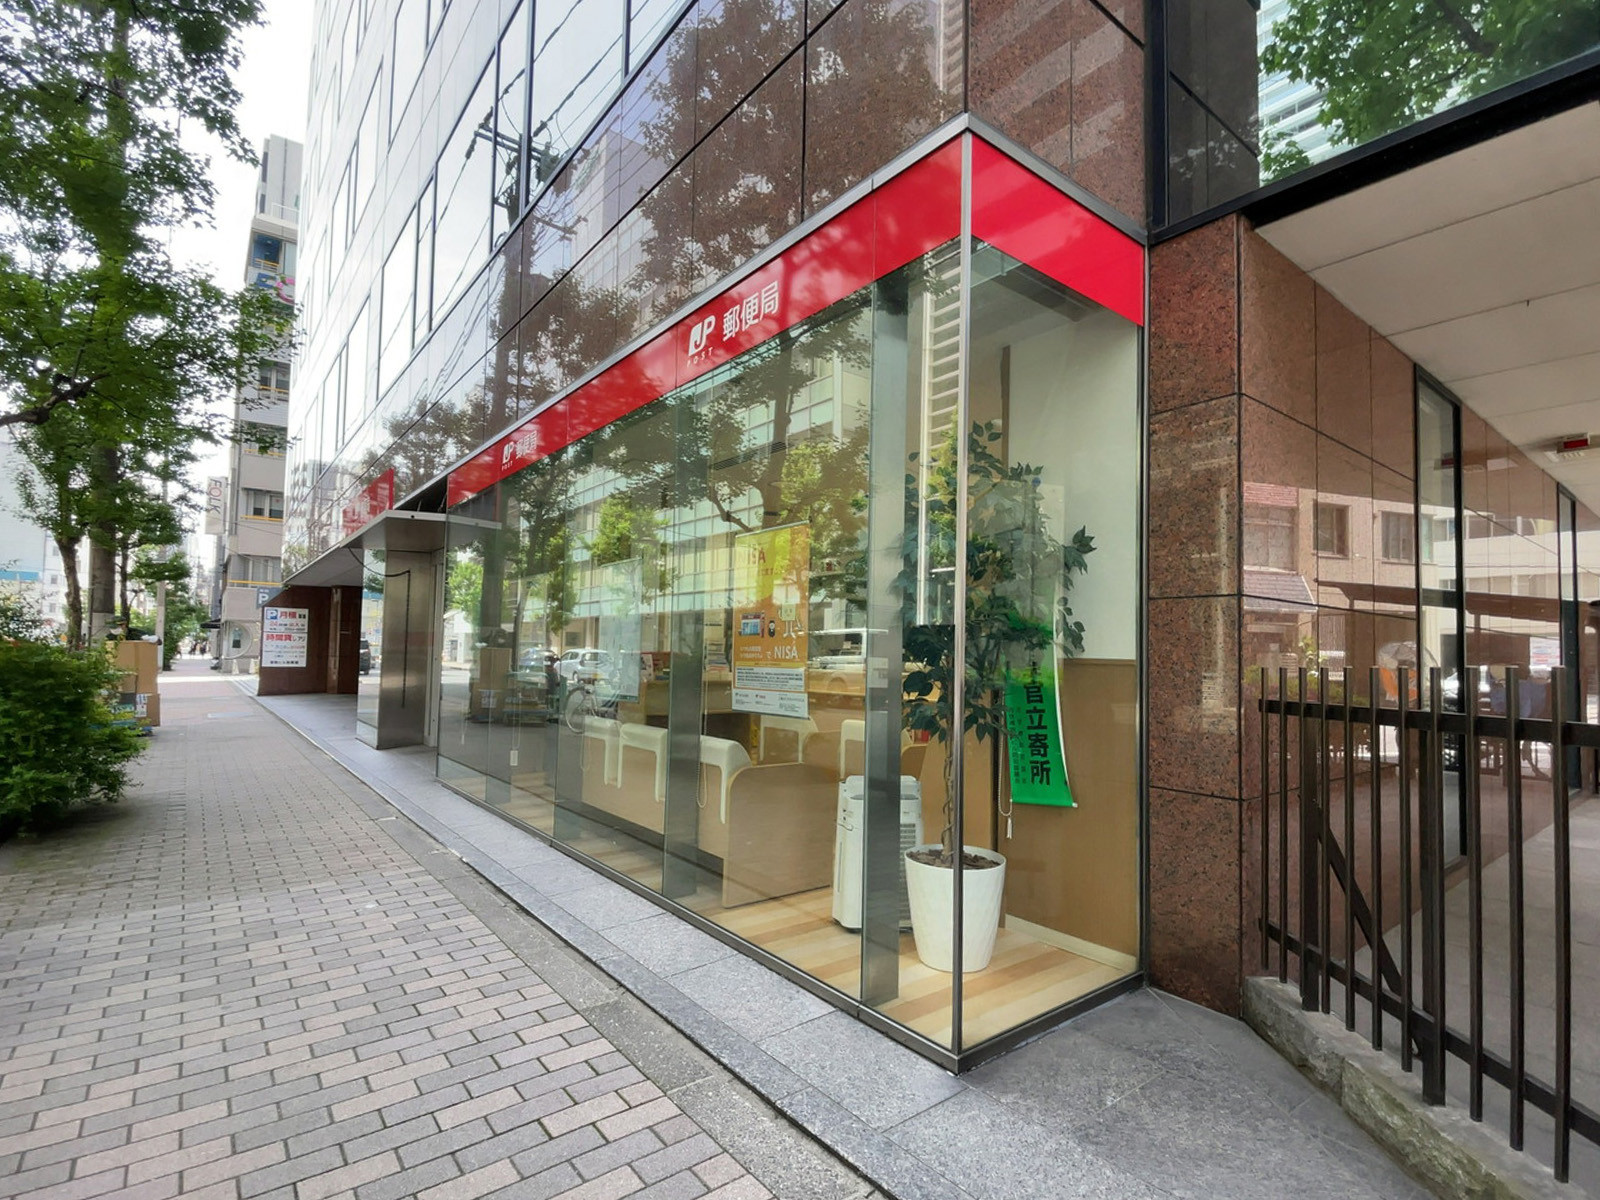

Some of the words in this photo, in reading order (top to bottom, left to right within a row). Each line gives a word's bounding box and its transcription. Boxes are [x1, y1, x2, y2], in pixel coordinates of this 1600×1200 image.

[722, 281, 779, 341] 郵便局
[516, 430, 537, 459] 郵便局
[208, 478, 222, 515] FOLK
[259, 593, 269, 604] P
[774, 645, 799, 660] NISA
